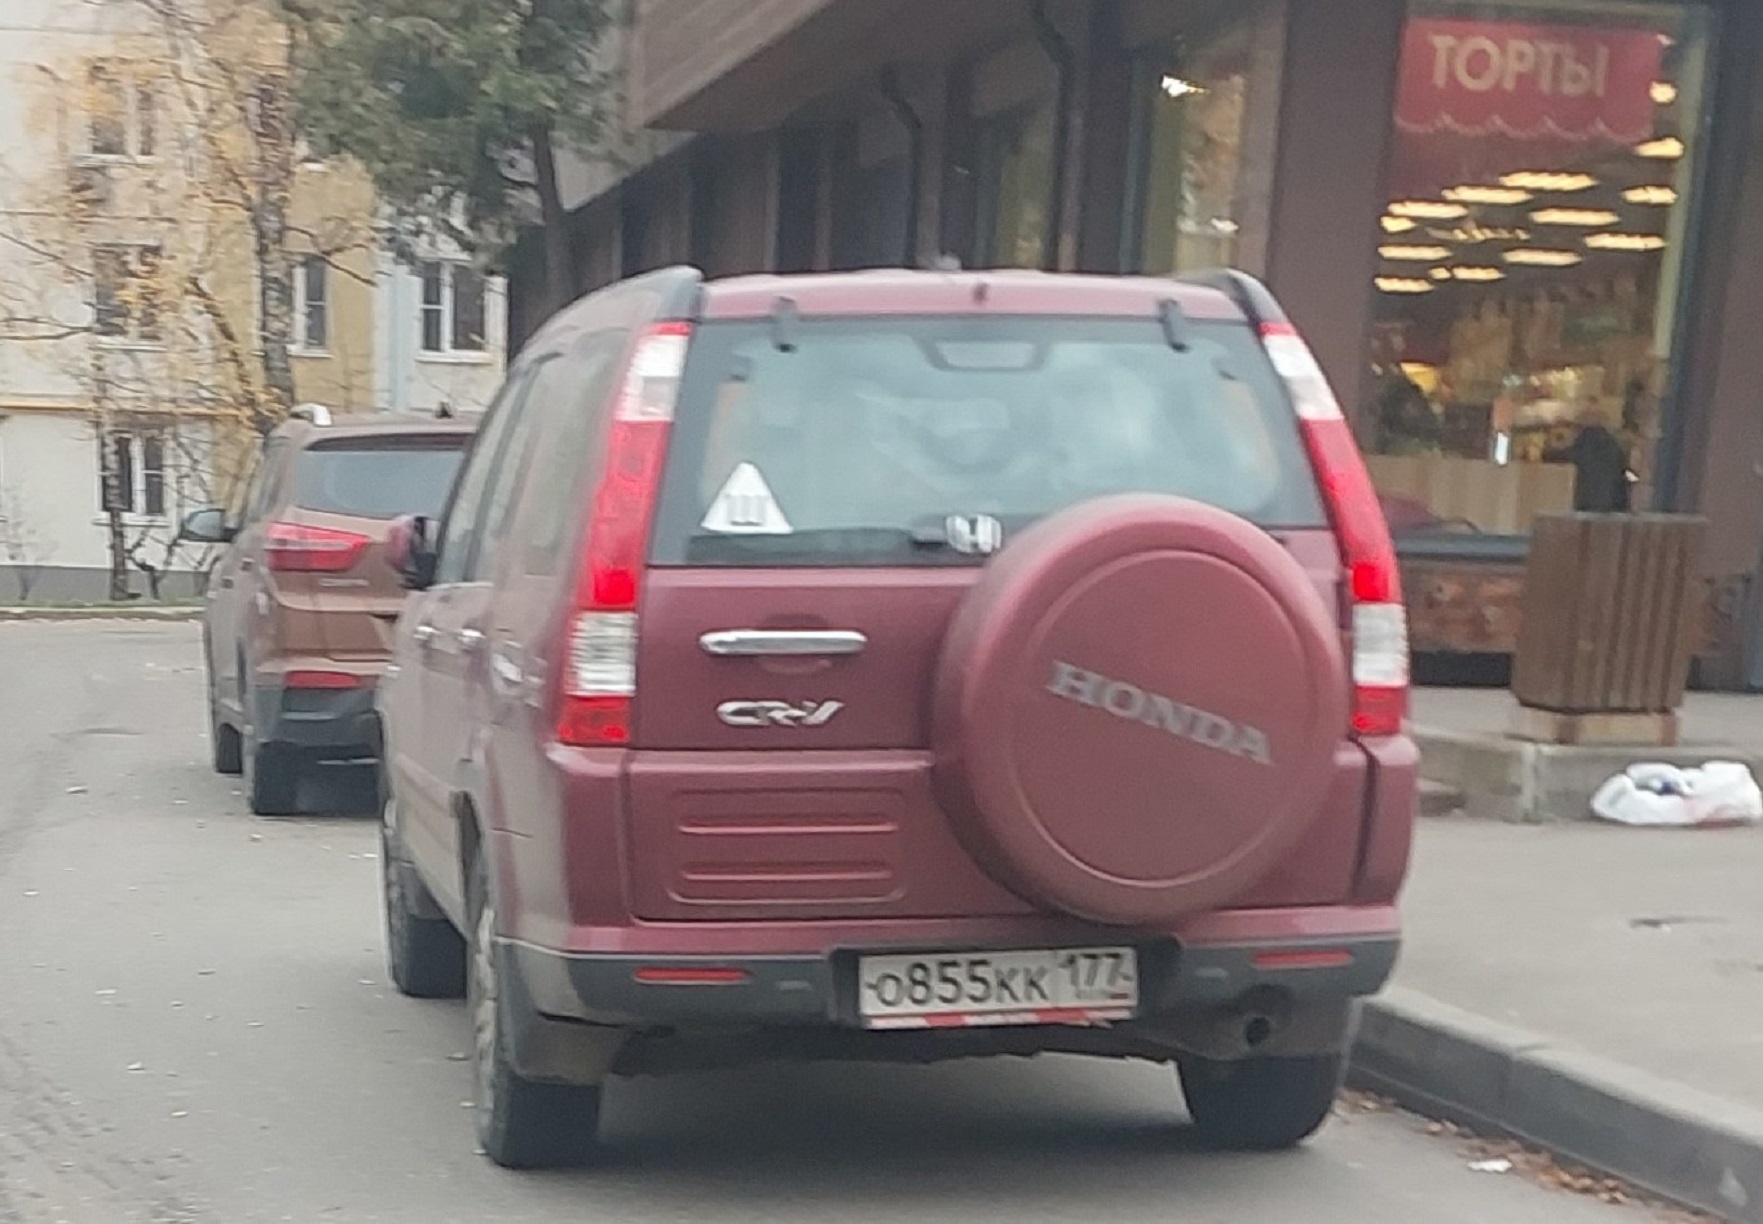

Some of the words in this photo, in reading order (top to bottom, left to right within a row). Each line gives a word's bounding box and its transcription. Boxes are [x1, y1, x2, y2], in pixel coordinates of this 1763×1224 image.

[1429, 35, 1610, 96] ТОРТЫ
[716, 700, 844, 726] CR-V
[1046, 661, 1273, 765] HONDA
